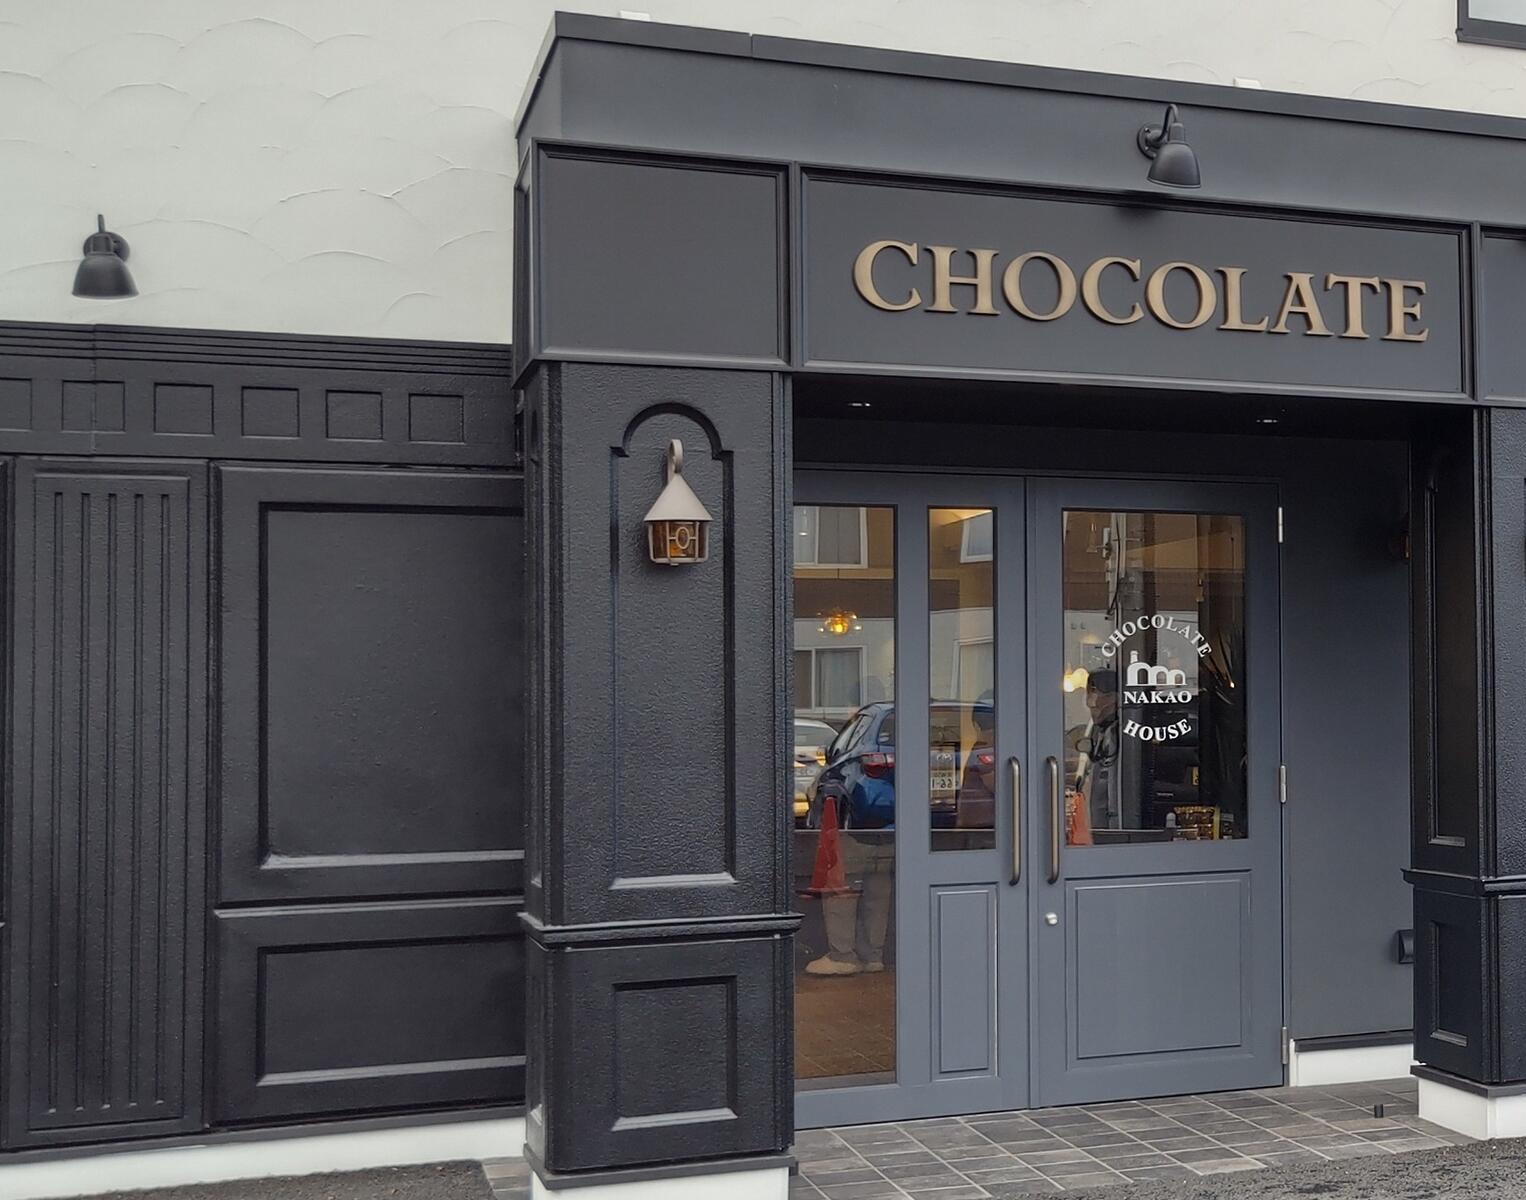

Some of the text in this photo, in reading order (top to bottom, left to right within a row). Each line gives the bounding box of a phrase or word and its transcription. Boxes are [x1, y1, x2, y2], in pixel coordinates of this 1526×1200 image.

[852, 239, 1430, 343] CHOCOLATE
[1101, 613, 1212, 658] CHOCOLATE
[1123, 690, 1193, 704] NAKAO
[1123, 718, 1192, 742] HOUSE
